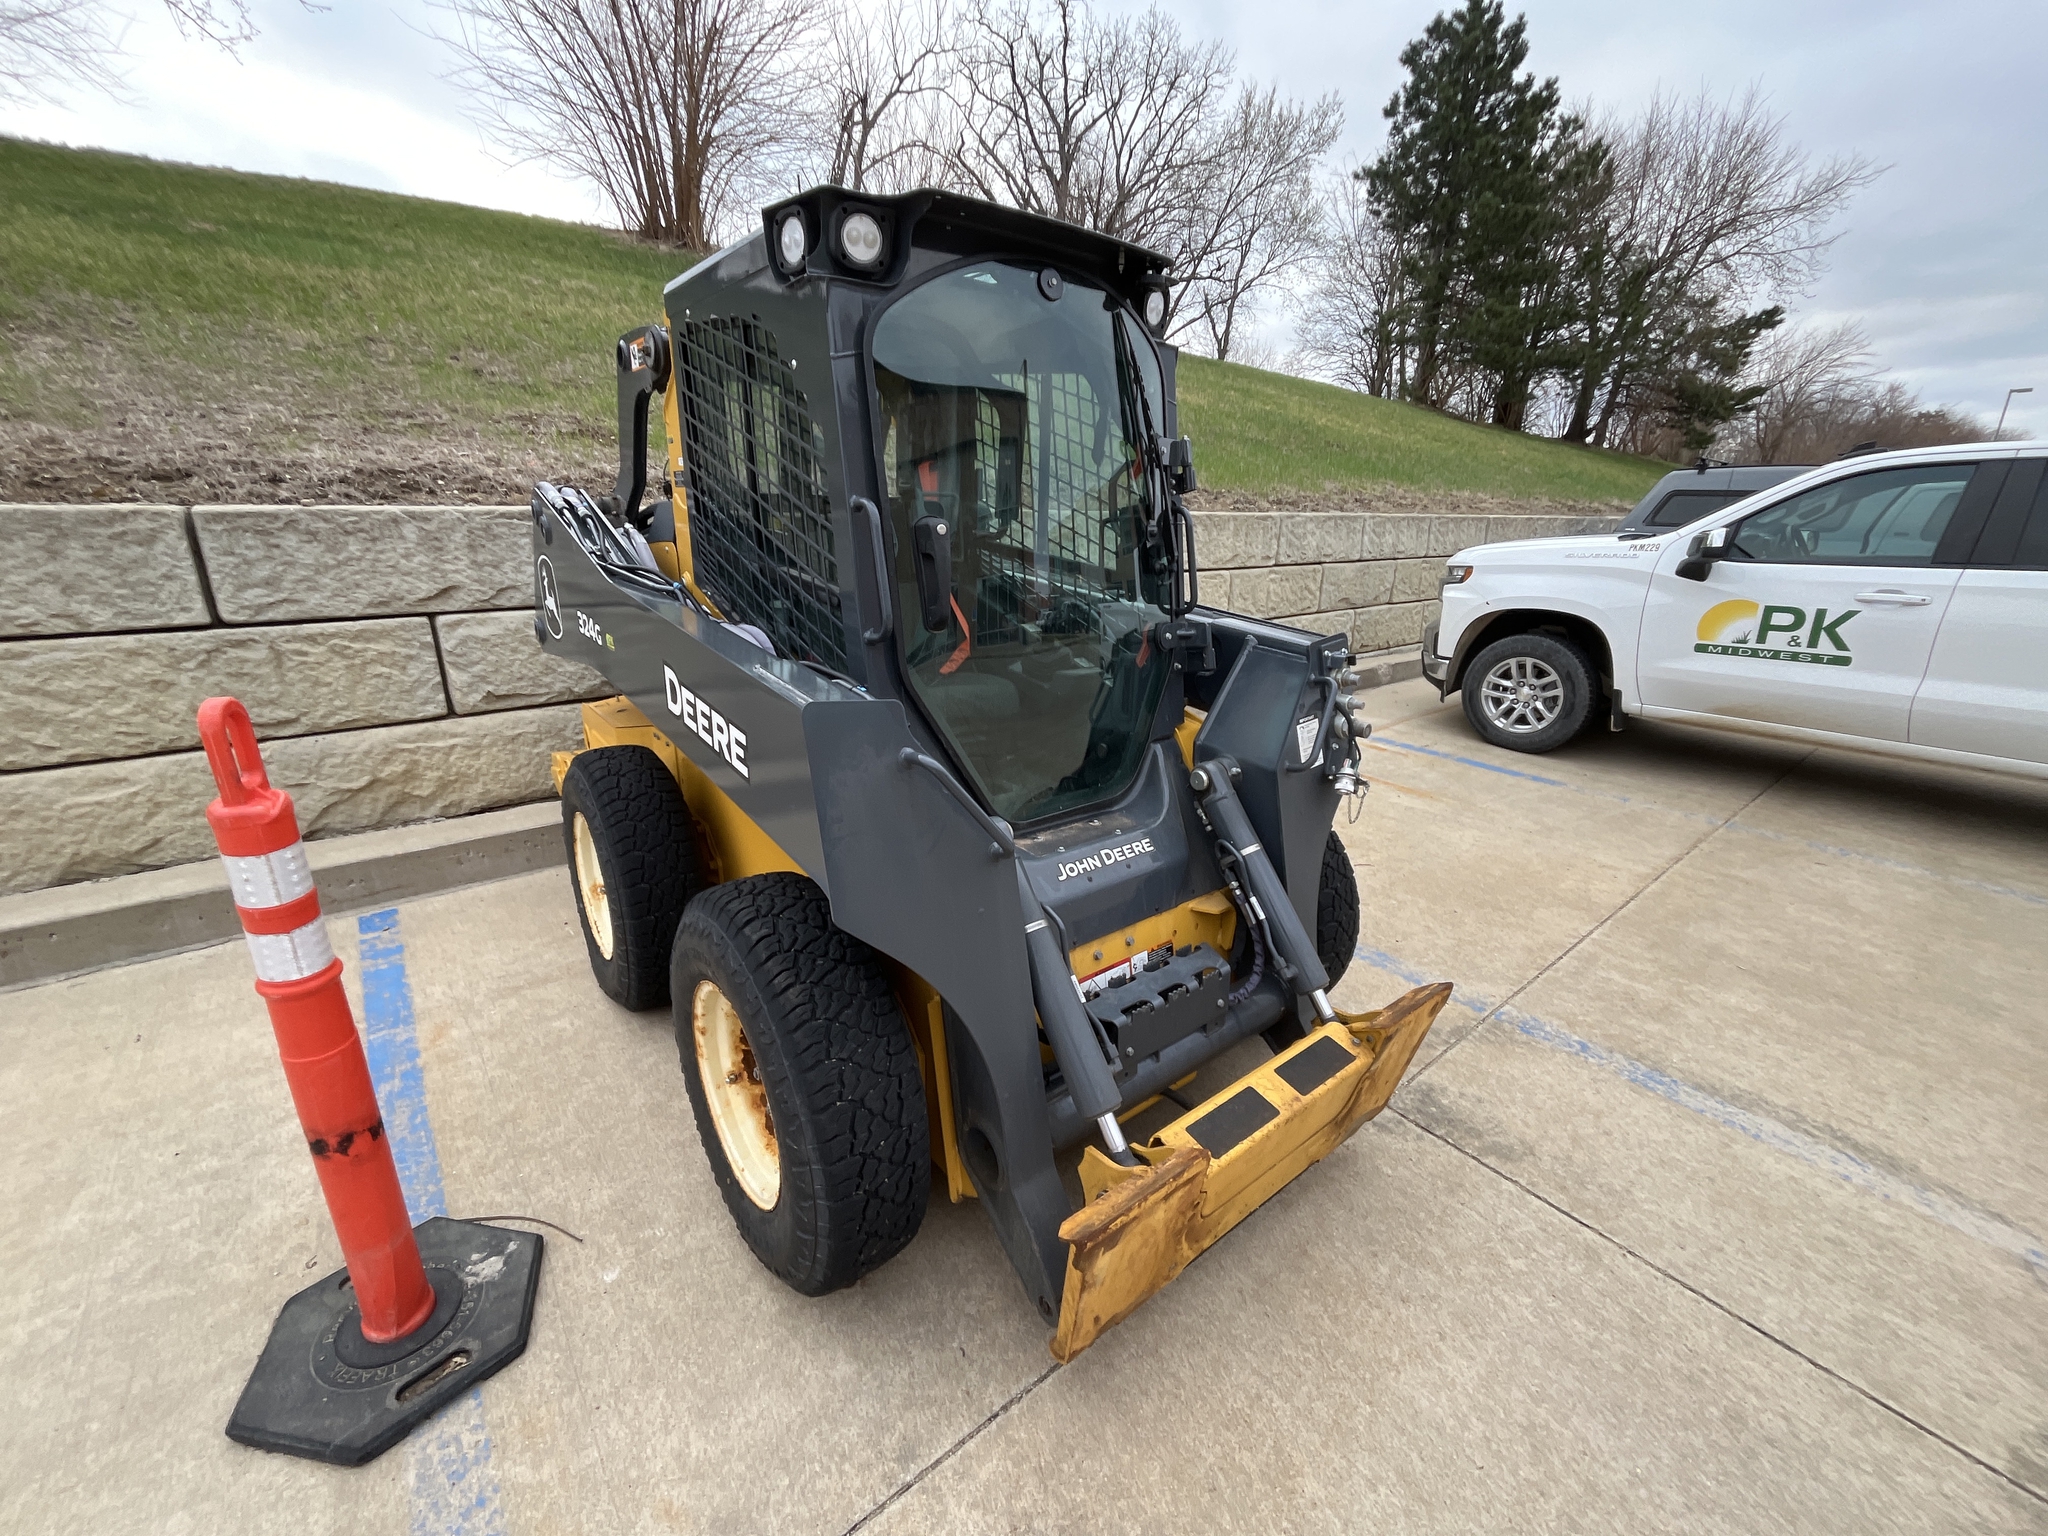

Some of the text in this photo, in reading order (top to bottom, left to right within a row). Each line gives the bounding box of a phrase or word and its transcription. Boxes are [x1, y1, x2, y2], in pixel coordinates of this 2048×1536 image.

[1628, 543, 1661, 552] PKM229
[576, 610, 603, 646] 324G
[1707, 645, 1834, 664] MIDWEST
[663, 664, 749, 779] DEERE
[1057, 838, 1155, 881] JOHN DEERE
